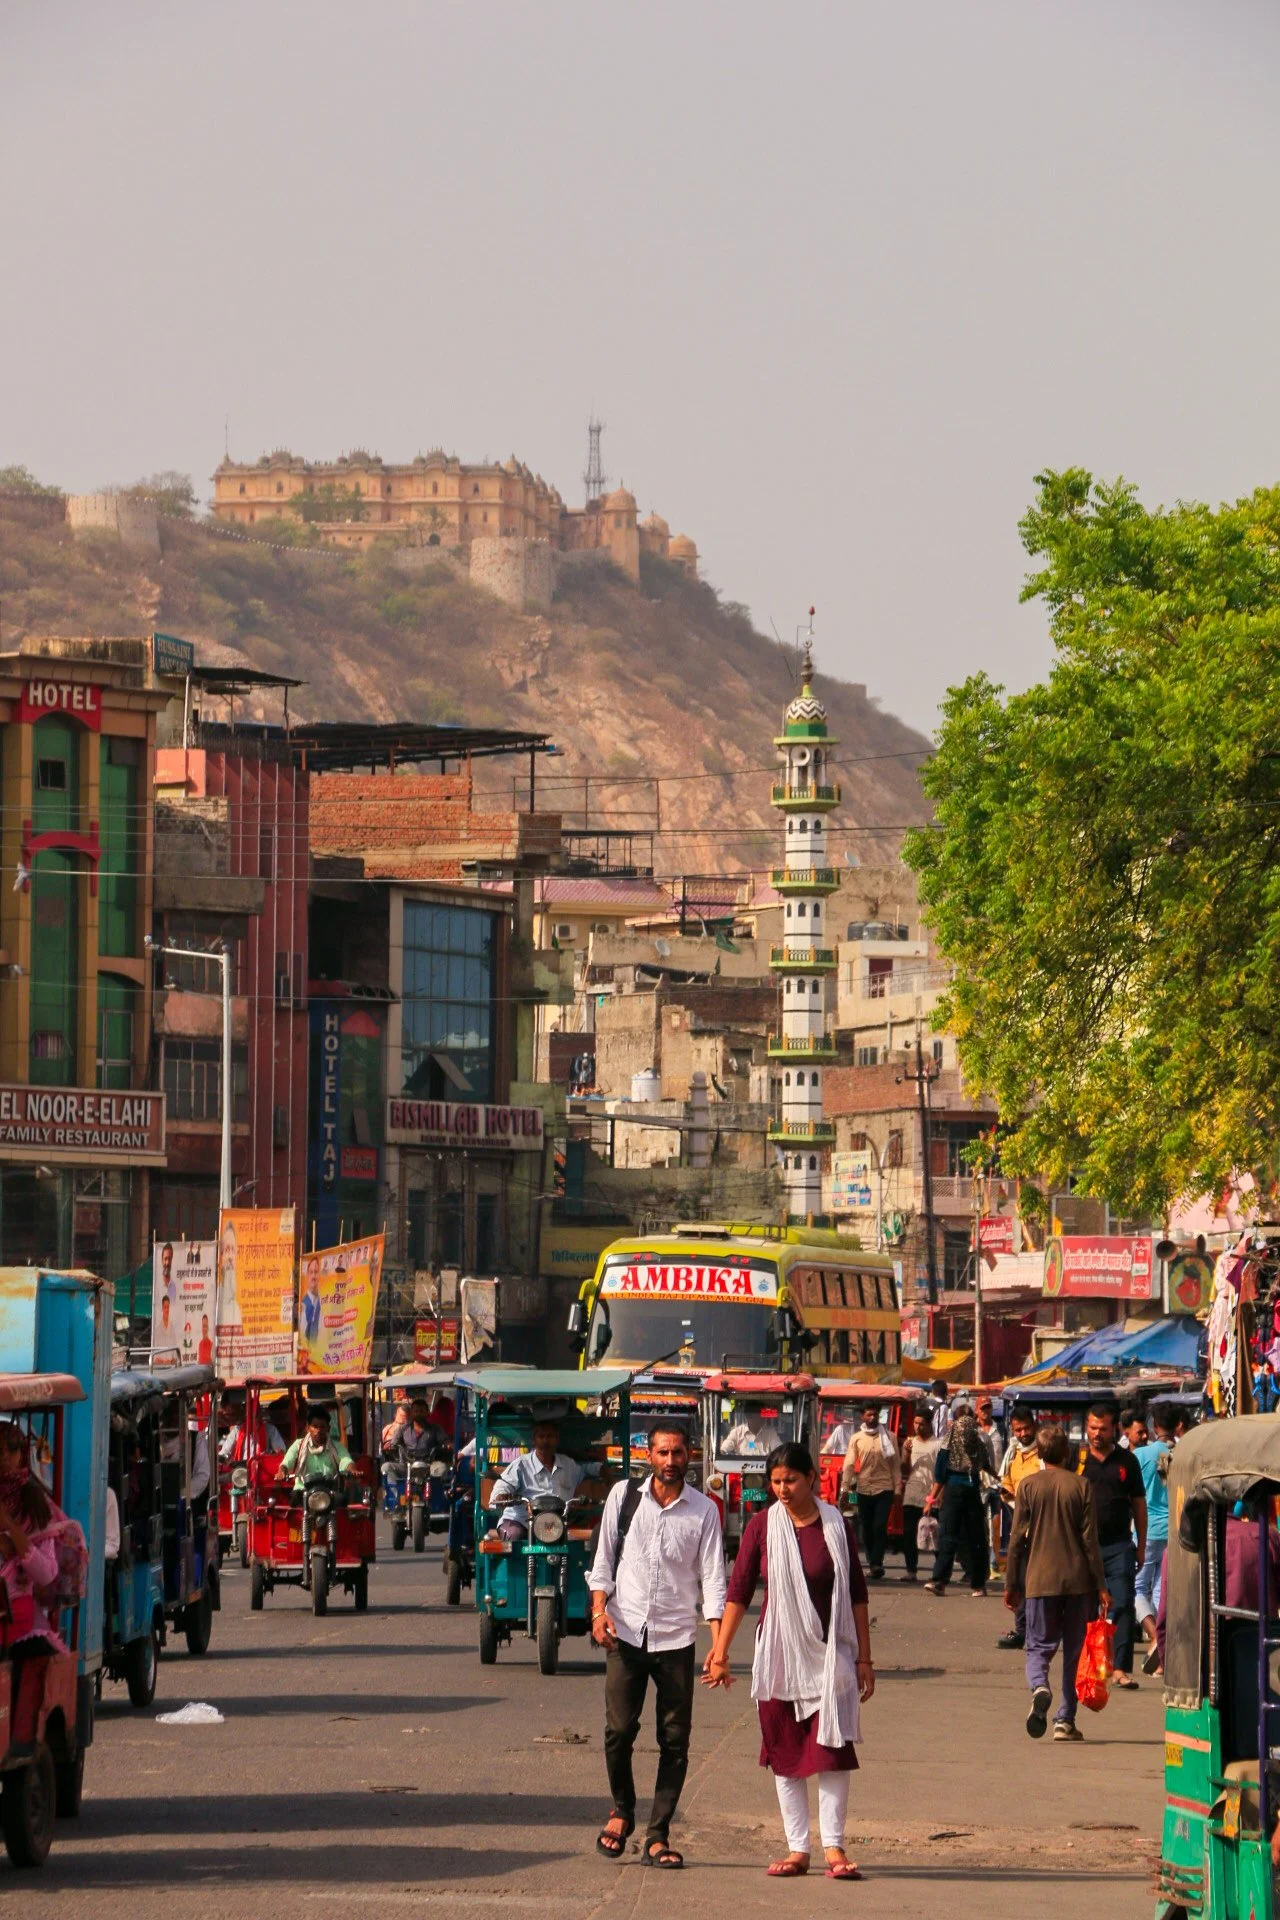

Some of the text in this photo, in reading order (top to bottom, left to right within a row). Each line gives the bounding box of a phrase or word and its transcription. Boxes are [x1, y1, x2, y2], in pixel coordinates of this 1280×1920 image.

[29, 682, 97, 710] HOTEL
[324, 1014, 338, 1113] HOTEL
[27, 1093, 151, 1127] NOOR-E-ELAHI
[390, 1101, 542, 1136] BISMILLAH HOTEL
[0, 1127, 150, 1147] FAMILY RESTAURANT
[322, 1123, 337, 1181] TAJ
[620, 1266, 754, 1296] AMBIKA
